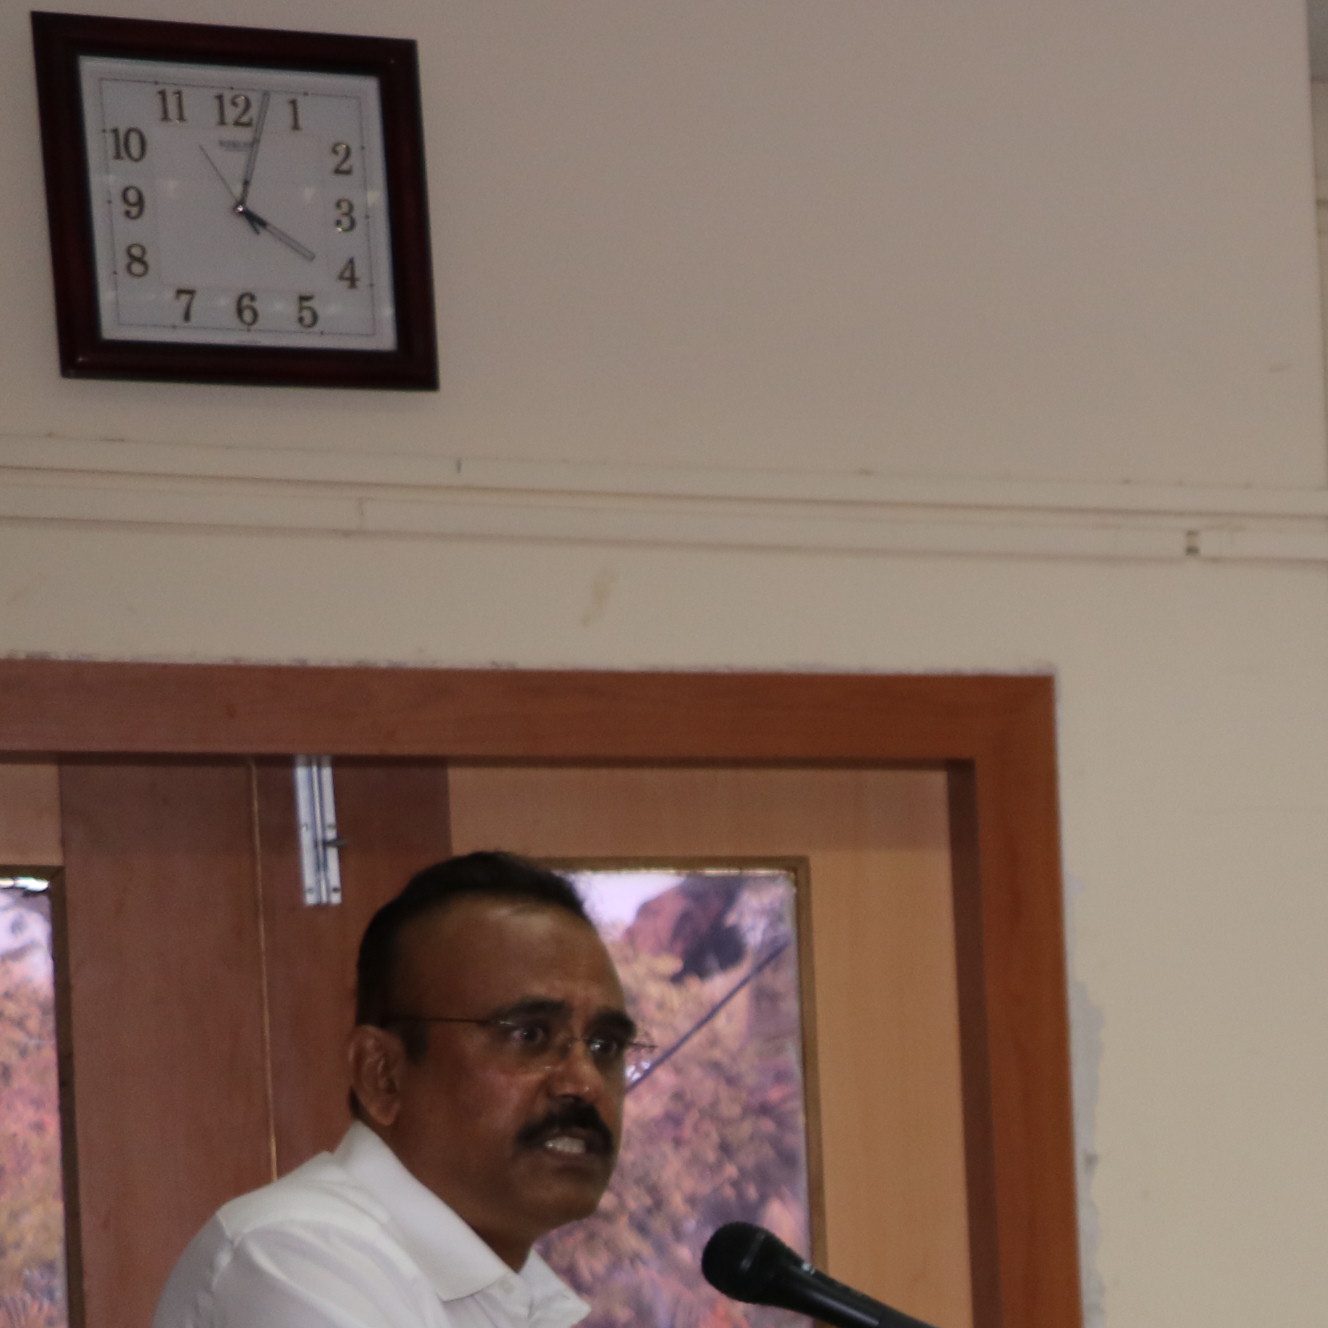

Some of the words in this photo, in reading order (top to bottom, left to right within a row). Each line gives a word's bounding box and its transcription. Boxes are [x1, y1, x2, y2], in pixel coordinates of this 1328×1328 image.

[156, 90, 187, 122] 11
[214, 94, 254, 127] 12
[288, 99, 302, 131] 1
[110, 127, 147, 161] 10
[331, 142, 354, 175] 2
[122, 186, 145, 220] 9
[334, 199, 356, 232] 3
[126, 243, 149, 277] 8
[337, 258, 360, 288] 4
[175, 289, 196, 323] 7
[235, 292, 259, 326] 6
[297, 295, 319, 328] 5
